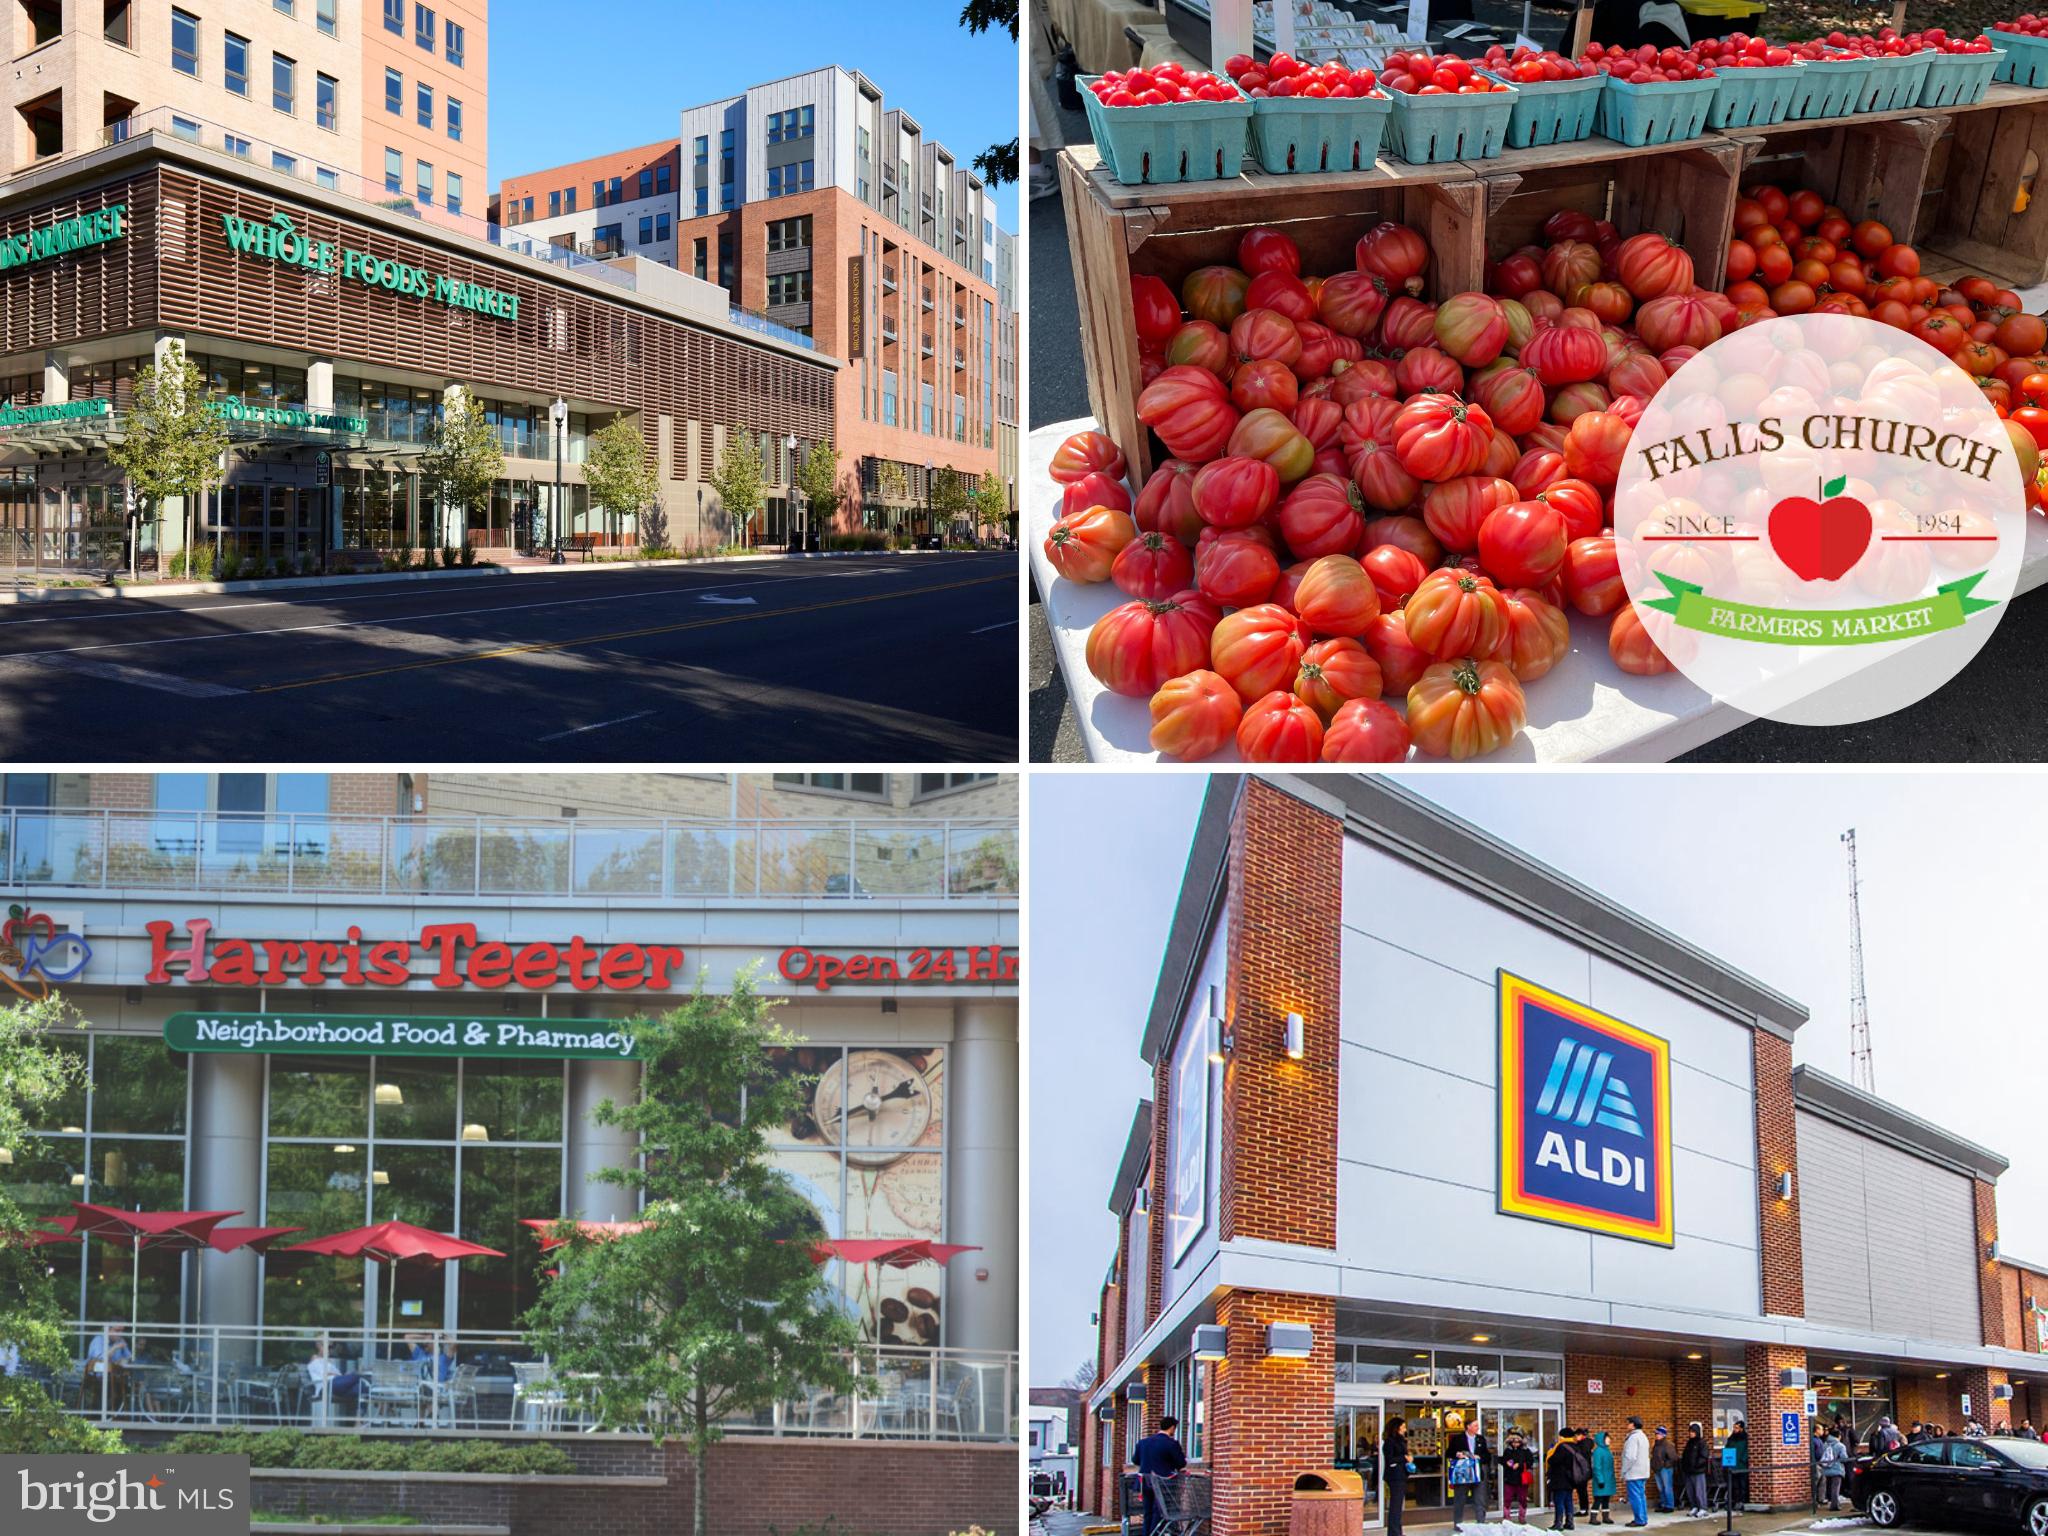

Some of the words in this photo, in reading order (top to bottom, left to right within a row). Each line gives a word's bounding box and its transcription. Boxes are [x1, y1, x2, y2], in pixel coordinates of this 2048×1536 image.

[31, 204, 126, 260] MARKET
[222, 213, 335, 274] WHOLE
[344, 249, 428, 298] FOODS
[435, 275, 521, 321] MARKET
[263, 407, 312, 428] FOODS
[315, 414, 369, 433] MARKET
[145, 918, 410, 986] Harris
[420, 922, 685, 991] Teeter
[778, 946, 898, 991] Open
[907, 947, 957, 982] 24
[196, 1019, 385, 1048] Neighborhood
[393, 1022, 457, 1045] Food
[463, 1023, 491, 1046] &
[497, 1024, 635, 1056] Pharmacy
[1535, 1130, 1646, 1193] ALDI
[1456, 1365, 1479, 1376] 155
